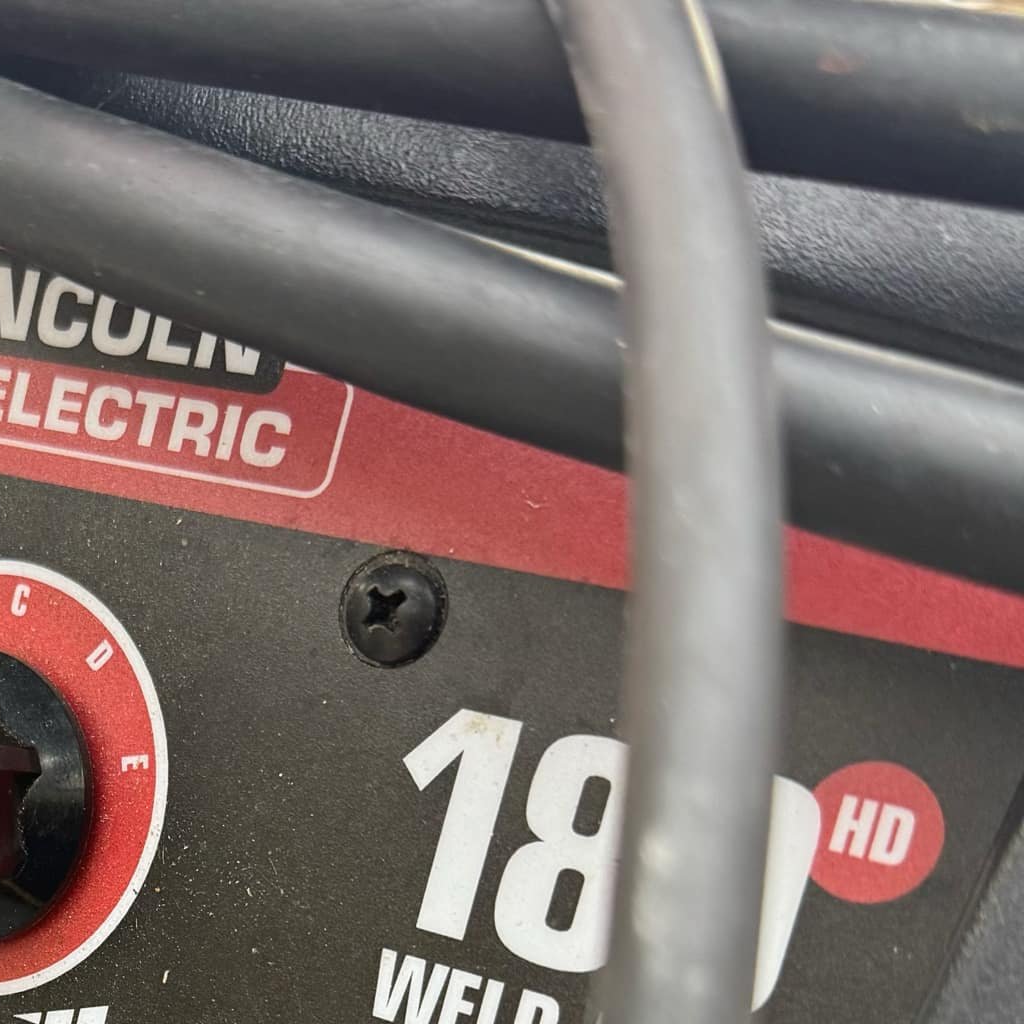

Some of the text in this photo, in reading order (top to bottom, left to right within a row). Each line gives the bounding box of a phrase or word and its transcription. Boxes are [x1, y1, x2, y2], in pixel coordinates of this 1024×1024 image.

[10, 584, 30, 616] C
[85, 639, 114, 671] D
[122, 754, 148, 772] E
[829, 795, 915, 866] HD
